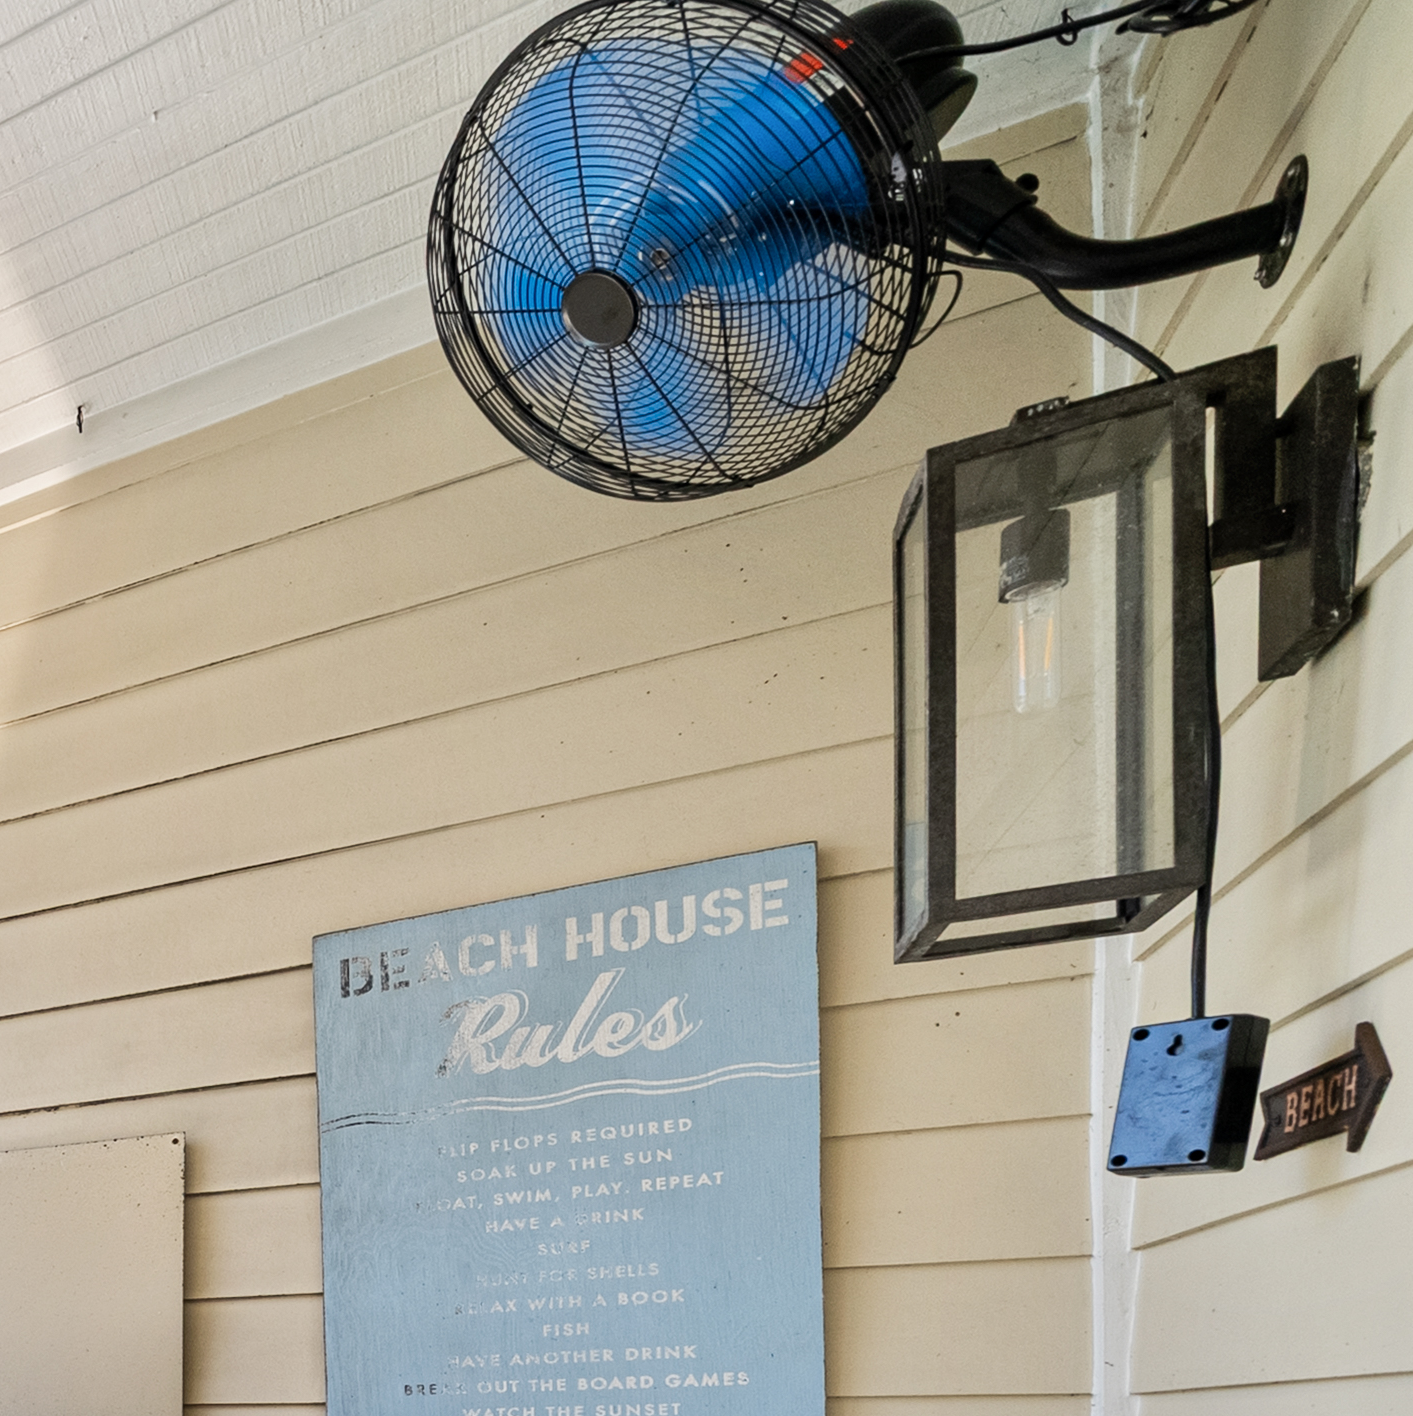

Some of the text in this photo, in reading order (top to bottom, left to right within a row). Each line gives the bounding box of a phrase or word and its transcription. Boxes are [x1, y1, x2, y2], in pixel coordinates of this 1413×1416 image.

[339, 878, 790, 998] BEACH HOUSE
[435, 967, 703, 1079] Rules
[1284, 1064, 1359, 1134] BEACH
[491, 1132, 558, 1154] FLOPS
[572, 1117, 693, 1144] REQUIRED
[457, 1148, 674, 1183] SOAK UP THE SUN
[642, 1172, 725, 1192] REPEAT
[486, 1216, 541, 1234] HAVE
[550, 1215, 566, 1229] A
[537, 1240, 591, 1256] SURF
[539, 1265, 577, 1281] FOR
[587, 1262, 660, 1279] SHELLS
[528, 1294, 582, 1311] WITH
[592, 1293, 609, 1307] A
[618, 1288, 685, 1305] BOOK
[542, 1321, 590, 1337] FISH
[510, 1347, 614, 1366] ANOTHER
[626, 1344, 697, 1362] DRINK
[477, 1379, 518, 1395] OUT
[529, 1378, 568, 1393] THE
[577, 1374, 654, 1391] BOARD
[665, 1371, 750, 1387] GAMES
